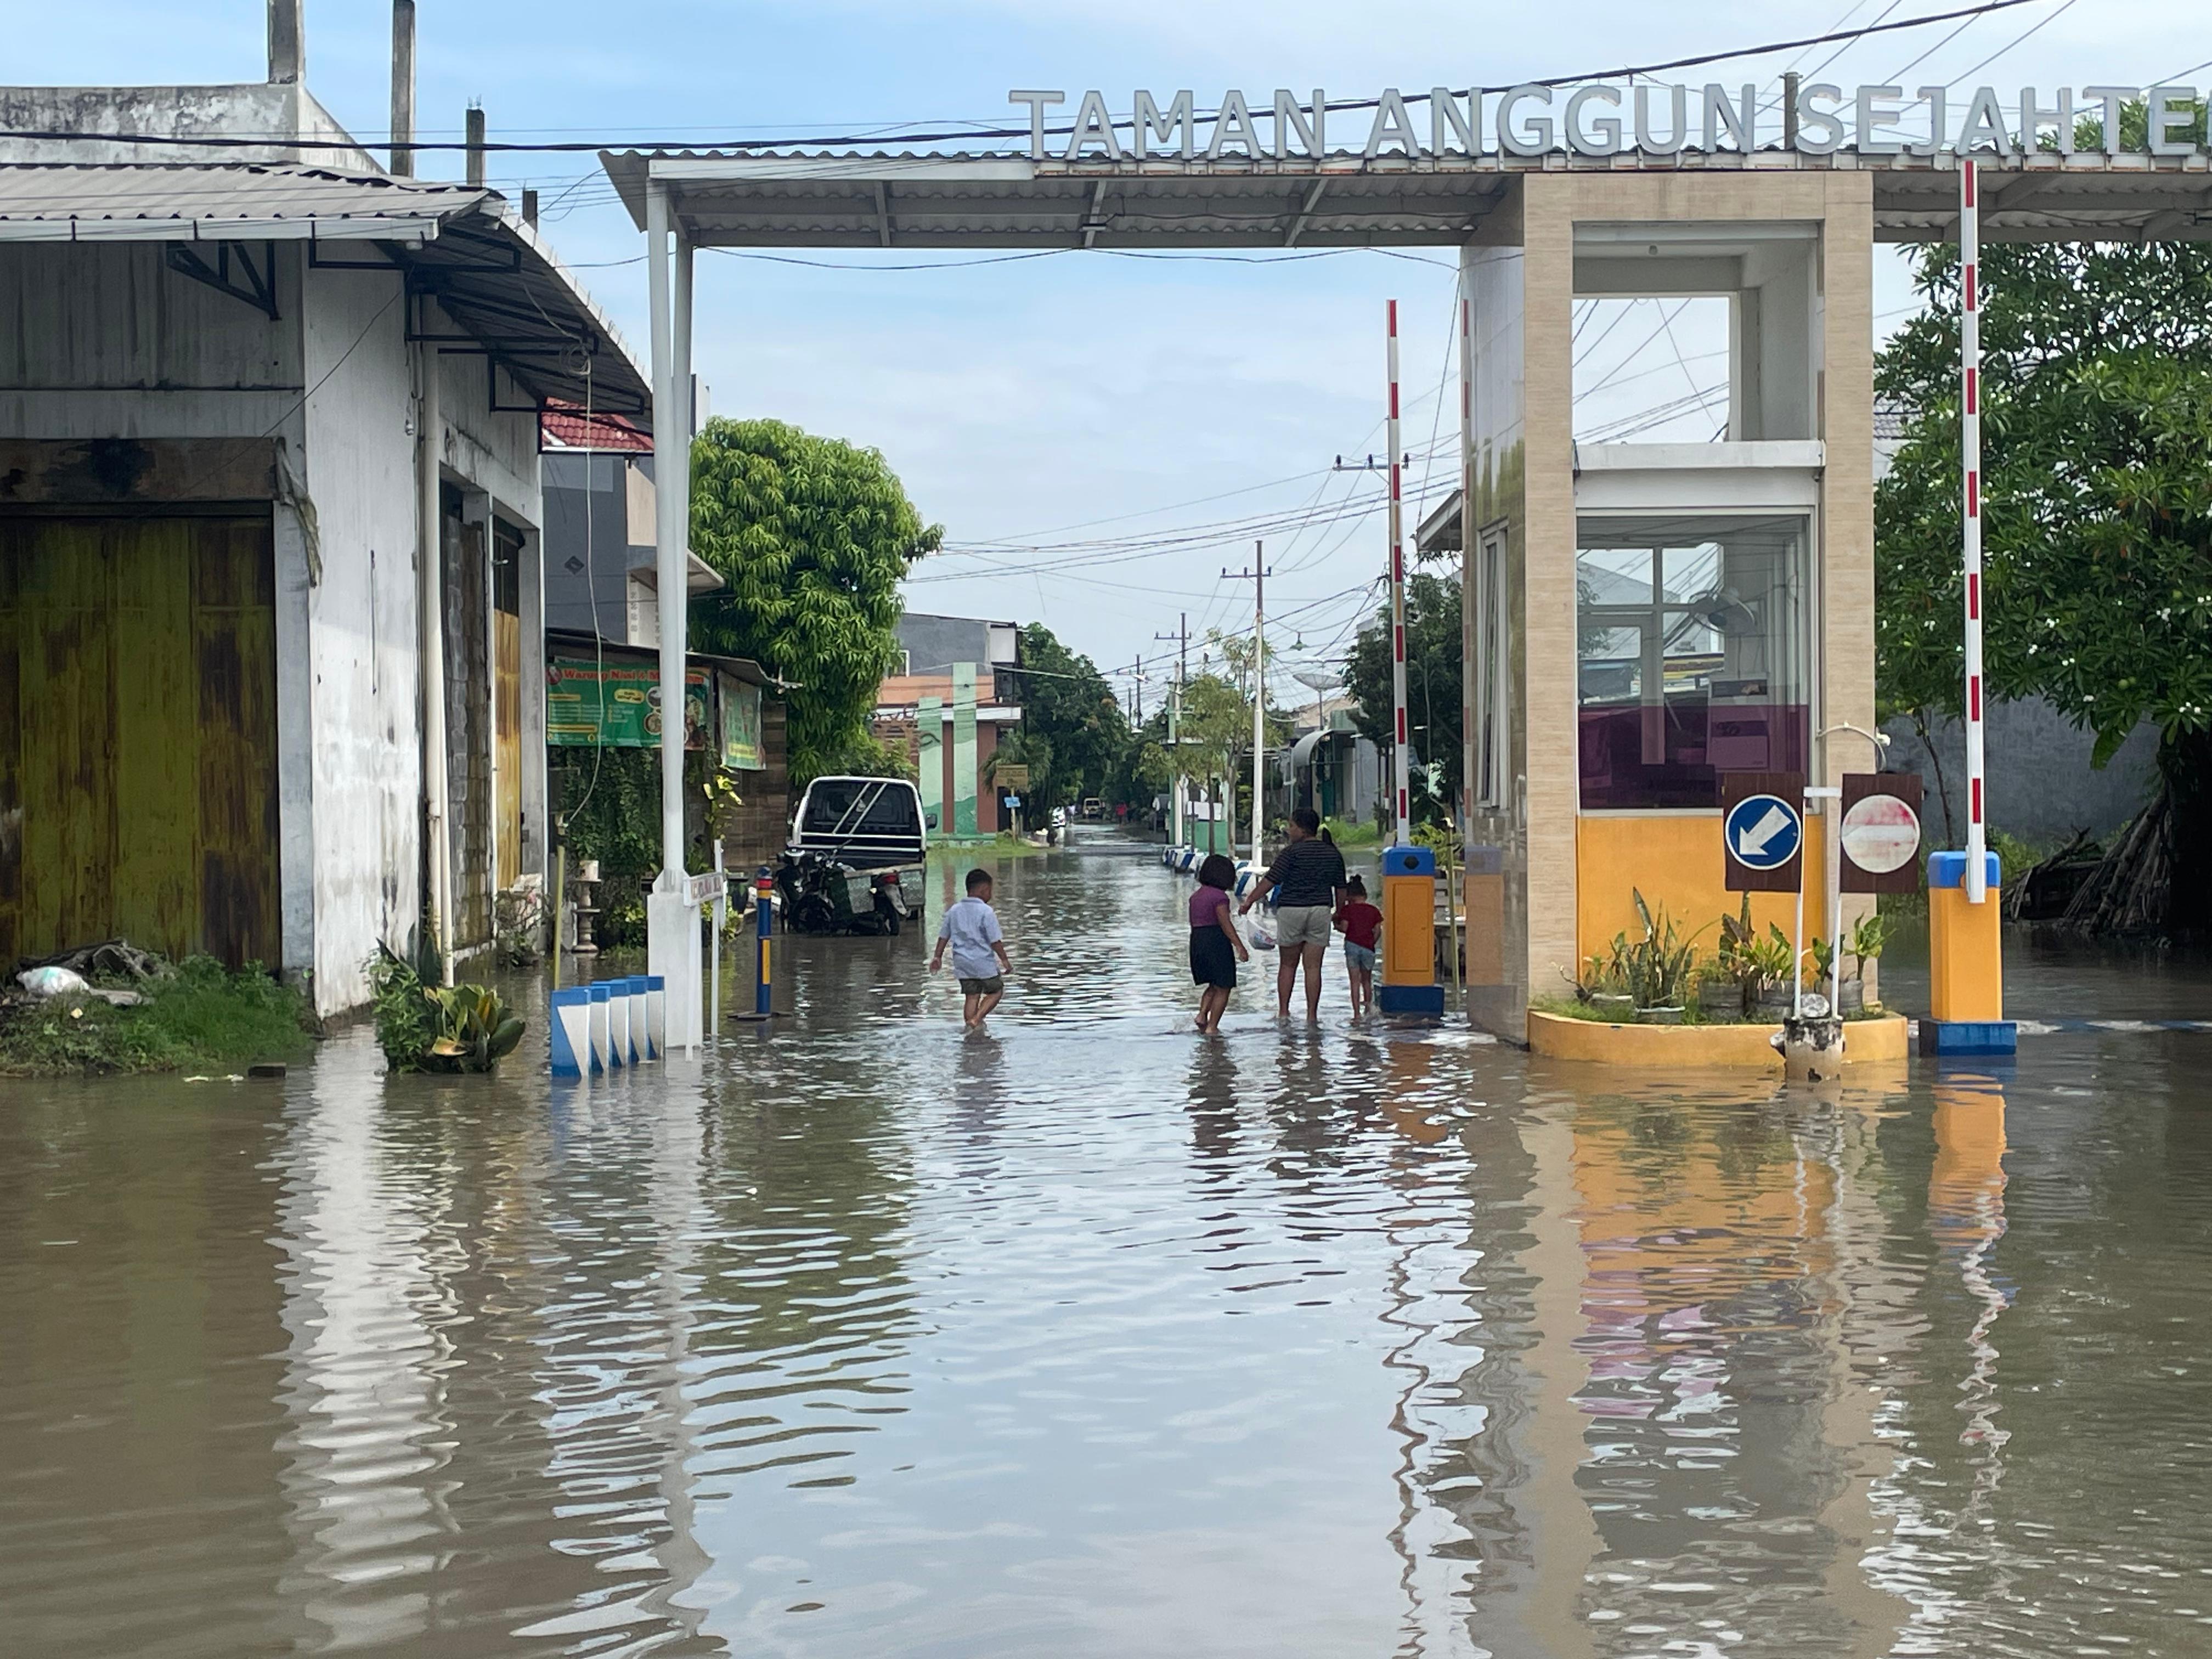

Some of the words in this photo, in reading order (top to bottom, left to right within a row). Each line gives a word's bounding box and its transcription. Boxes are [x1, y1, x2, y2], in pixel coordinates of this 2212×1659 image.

[1008, 88, 1325, 161] TAMAN
[1364, 84, 1756, 159] ANGGUN
[1793, 83, 2212, 157] SEJAHTE
